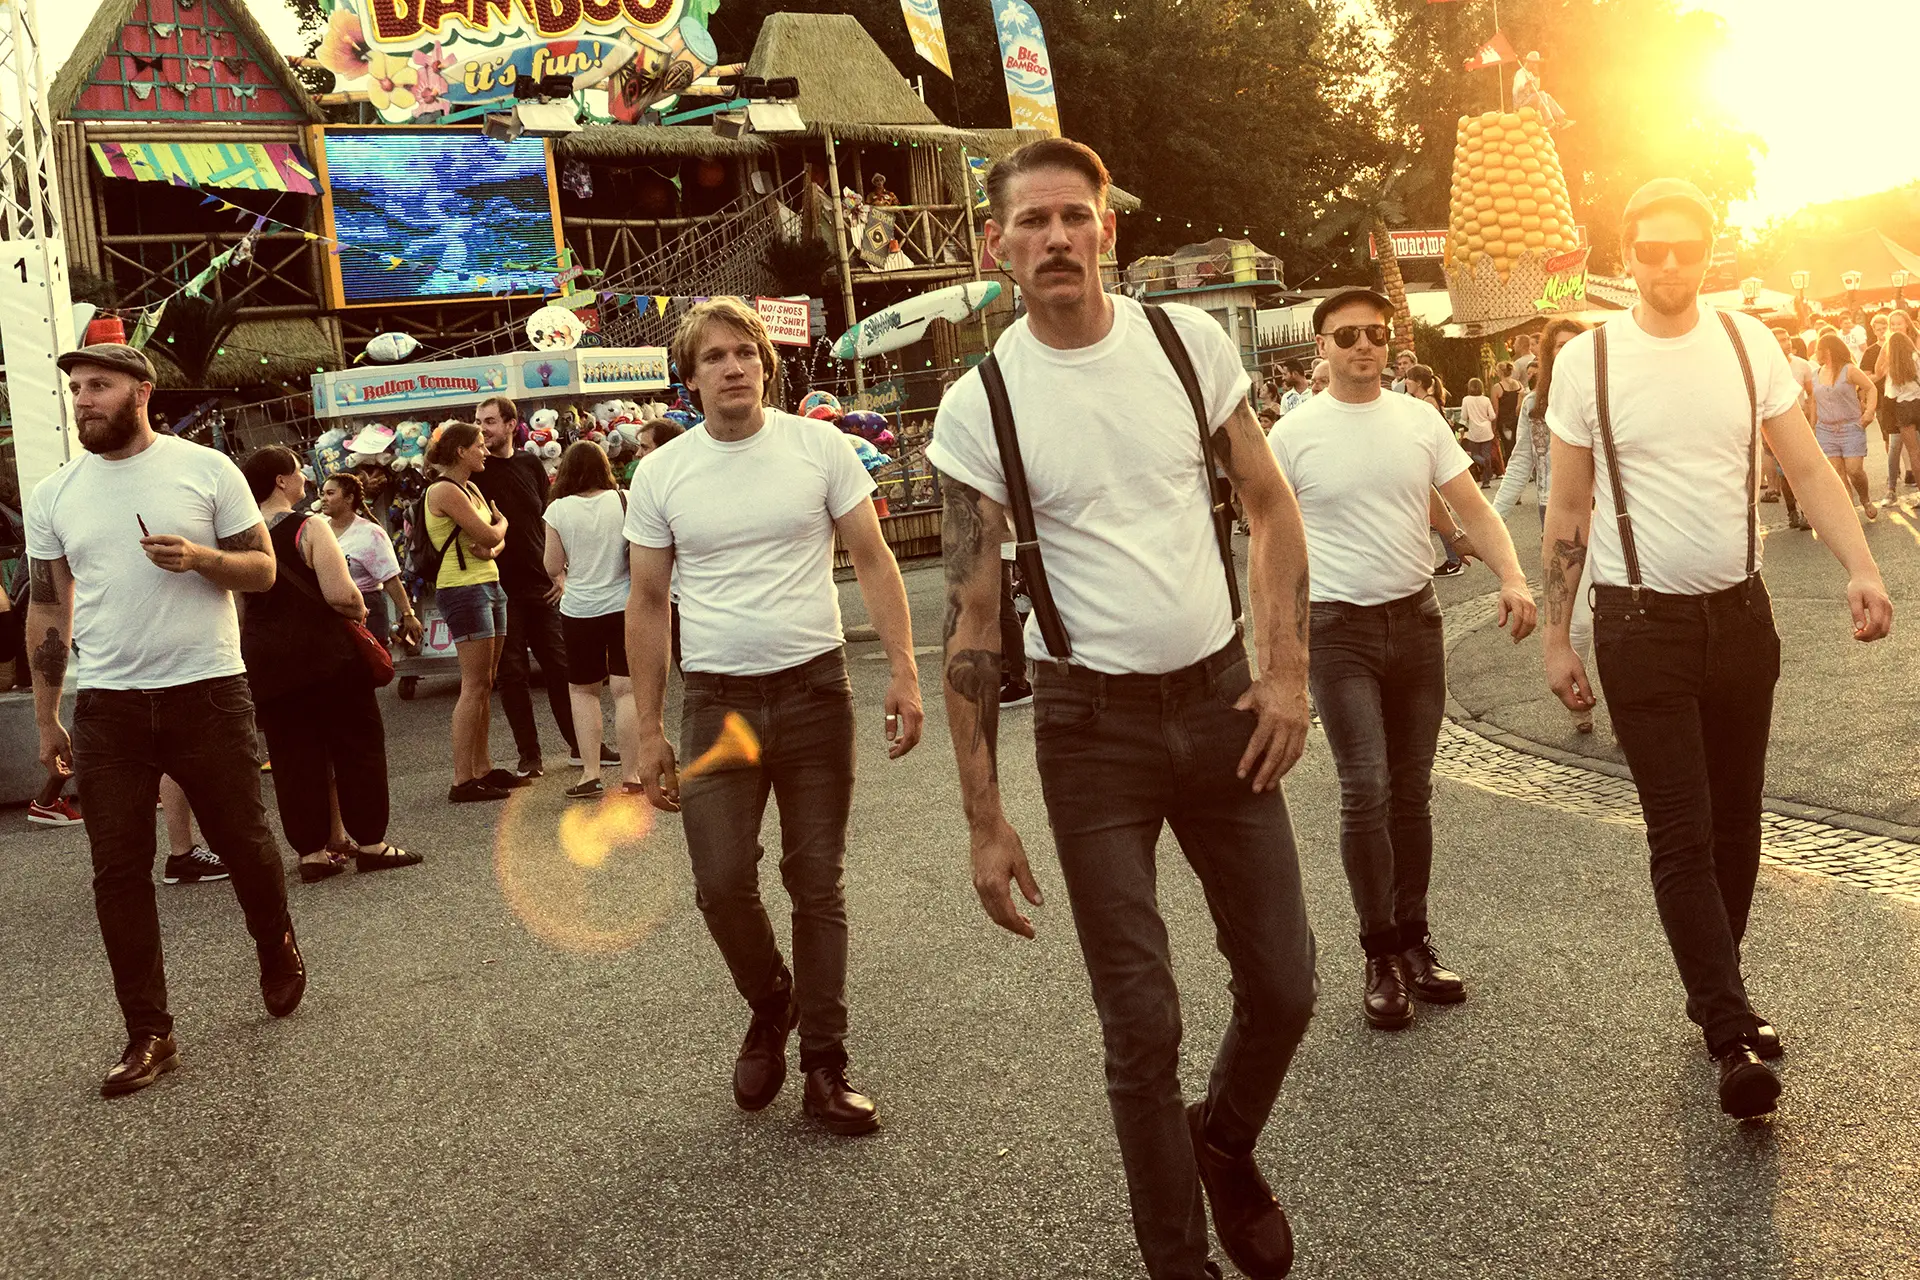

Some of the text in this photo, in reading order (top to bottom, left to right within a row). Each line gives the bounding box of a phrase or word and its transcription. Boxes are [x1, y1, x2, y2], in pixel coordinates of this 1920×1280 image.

[1017, 46, 1038, 63] BIG
[463, 41, 602, 94] it's fun!
[1006, 56, 1047, 76] BAMBOO
[1014, 106, 1032, 119] it's
[14, 257, 28, 283] 1
[761, 304, 803, 316] NO! SHOES
[777, 315, 806, 328] T-SHIRT
[774, 325, 806, 338] PROBLEM
[362, 378, 417, 401] Ballon
[417, 374, 481, 393] Tommy
